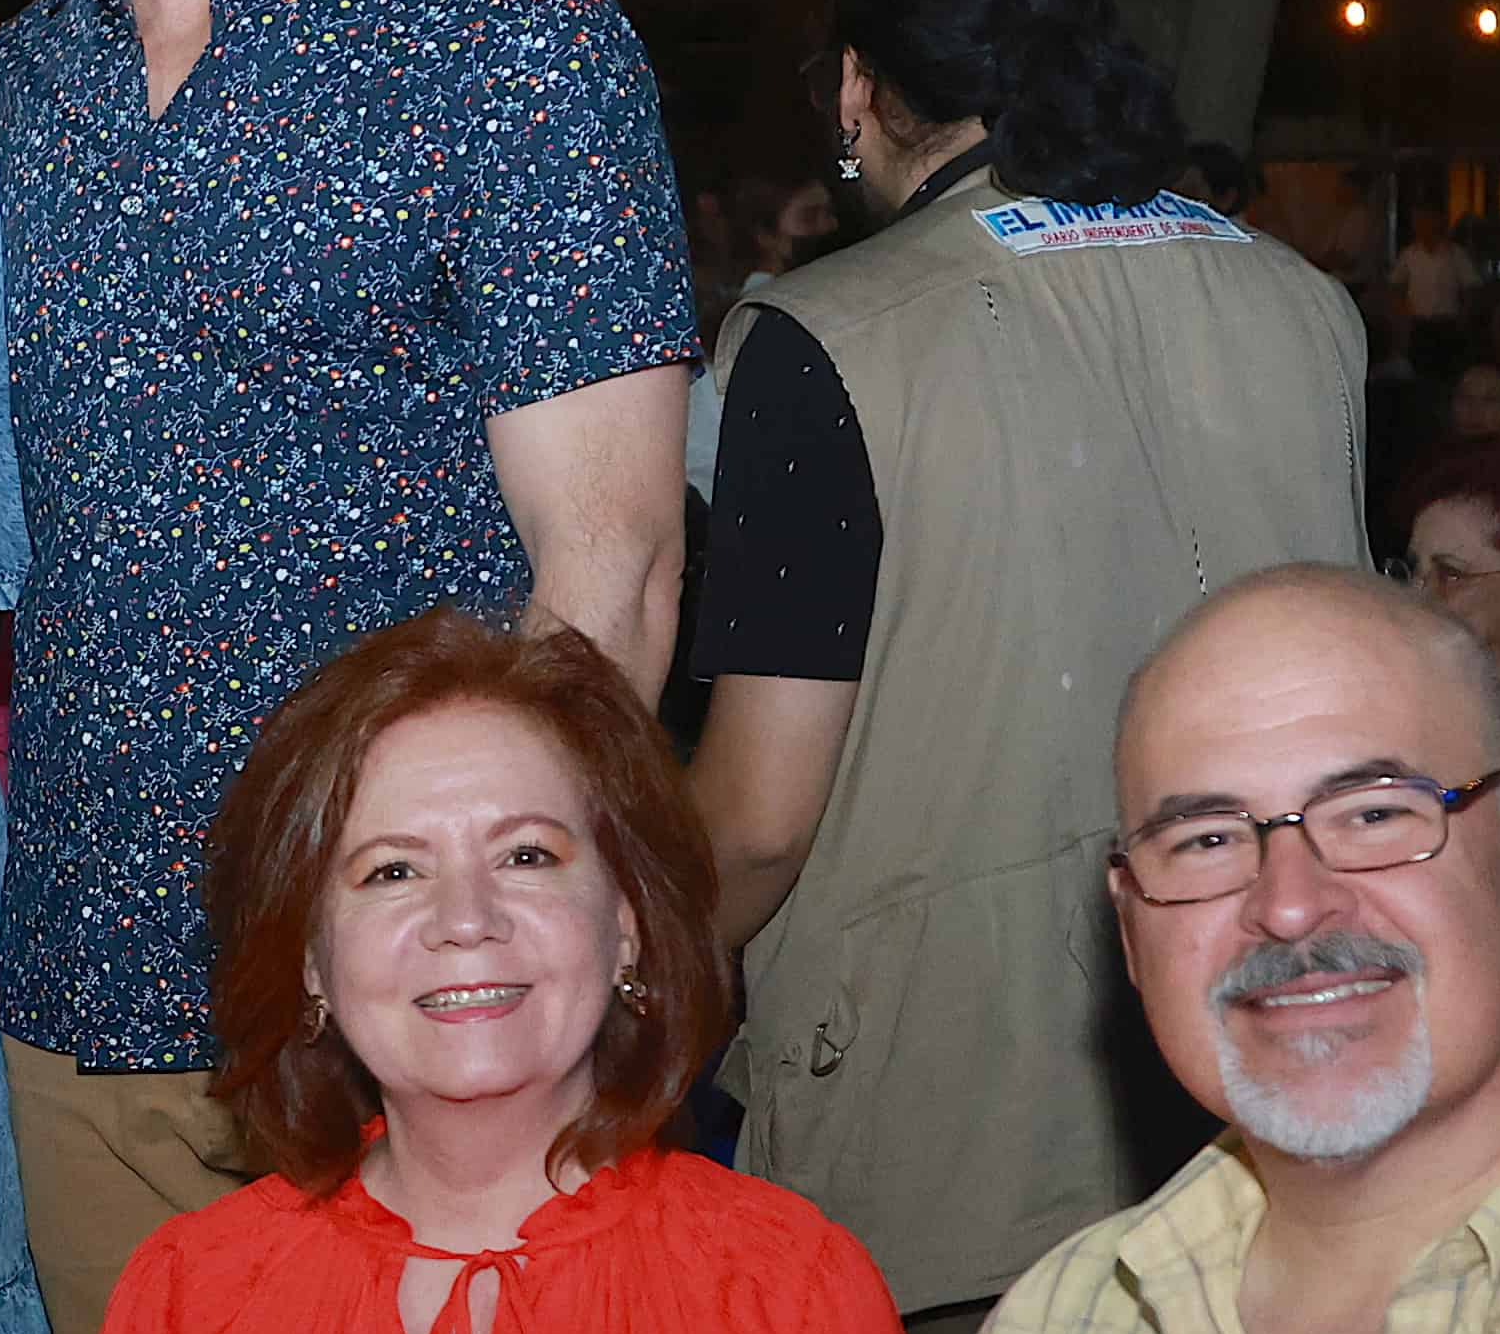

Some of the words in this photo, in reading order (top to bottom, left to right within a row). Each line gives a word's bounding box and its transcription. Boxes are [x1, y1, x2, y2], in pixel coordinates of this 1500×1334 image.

[985, 206, 1047, 237] EL
[1042, 230, 1079, 245] DIARIO
[1083, 223, 1155, 240] INDEPENDIENTE
[1160, 221, 1177, 236] DE
